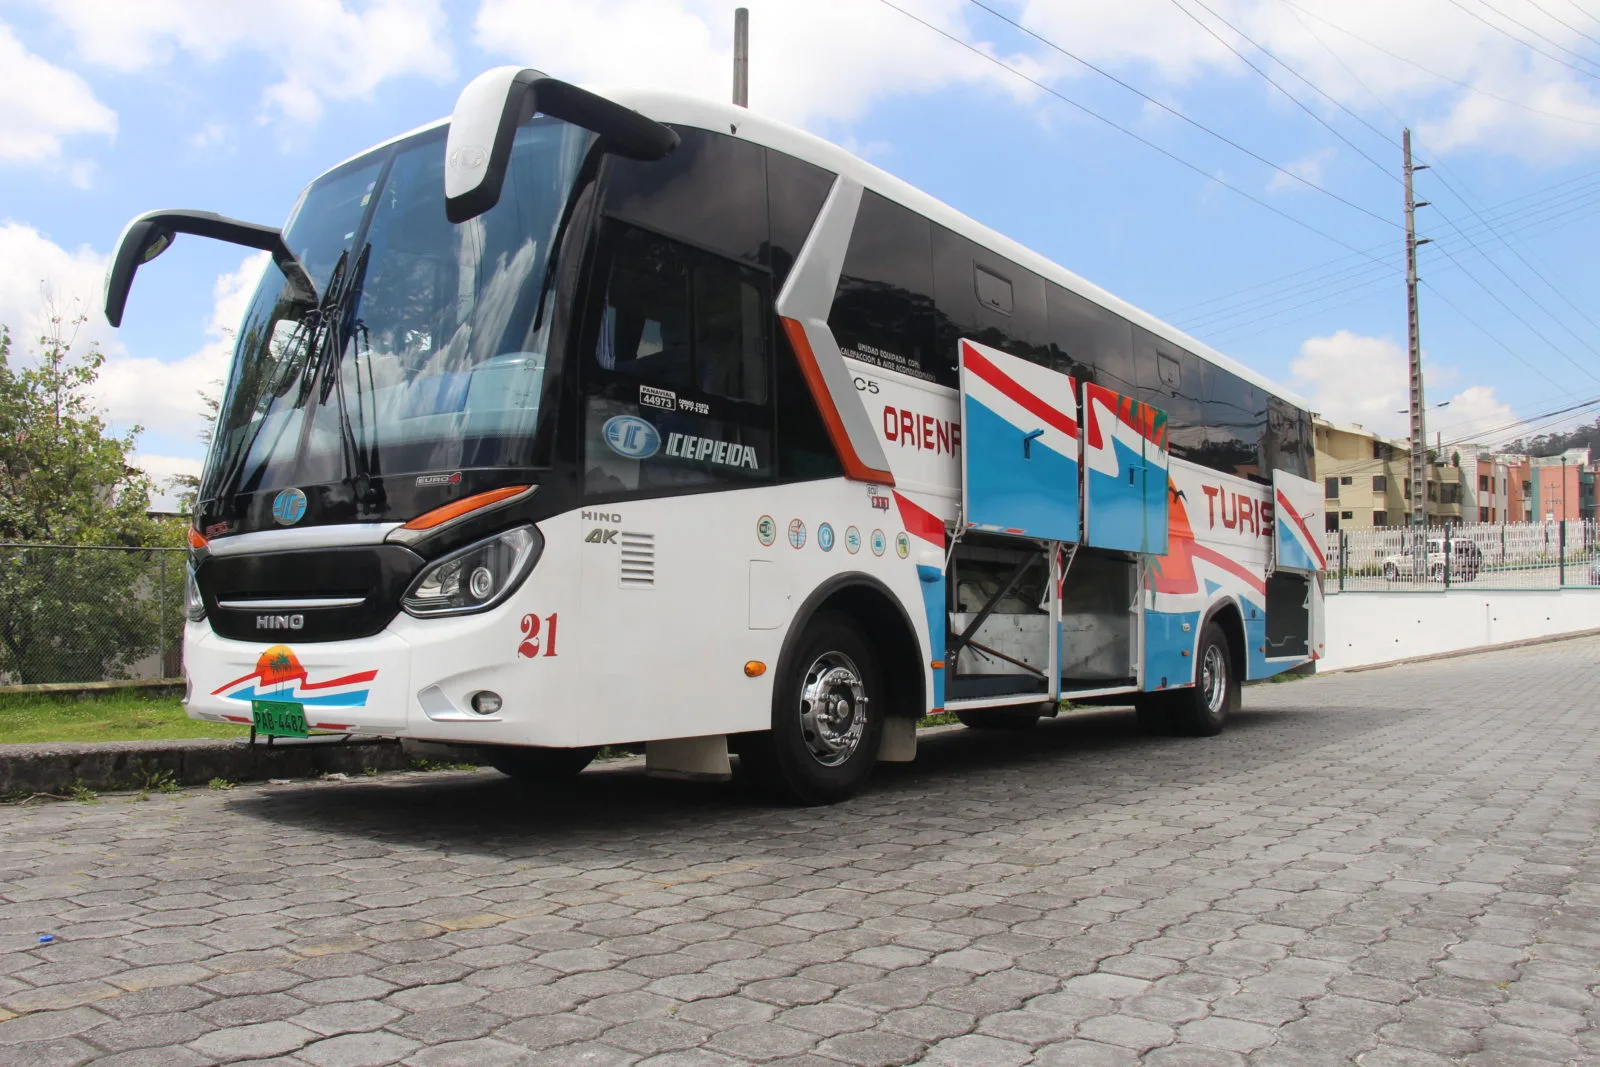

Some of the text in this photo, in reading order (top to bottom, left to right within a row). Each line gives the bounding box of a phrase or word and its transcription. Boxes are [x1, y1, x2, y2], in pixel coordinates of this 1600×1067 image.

[858, 342, 879, 356] UNIDAD
[883, 360, 895, 371] AIRE
[643, 387, 673, 398] PANAVIAL
[853, 377, 880, 394] C5
[643, 394, 672, 408] 44973
[665, 432, 759, 470] CEPEDA
[873, 497, 888, 508] 911
[581, 510, 622, 524] HINO
[584, 528, 619, 545] AK
[256, 614, 305, 630] HINO
[517, 612, 558, 659] 21
